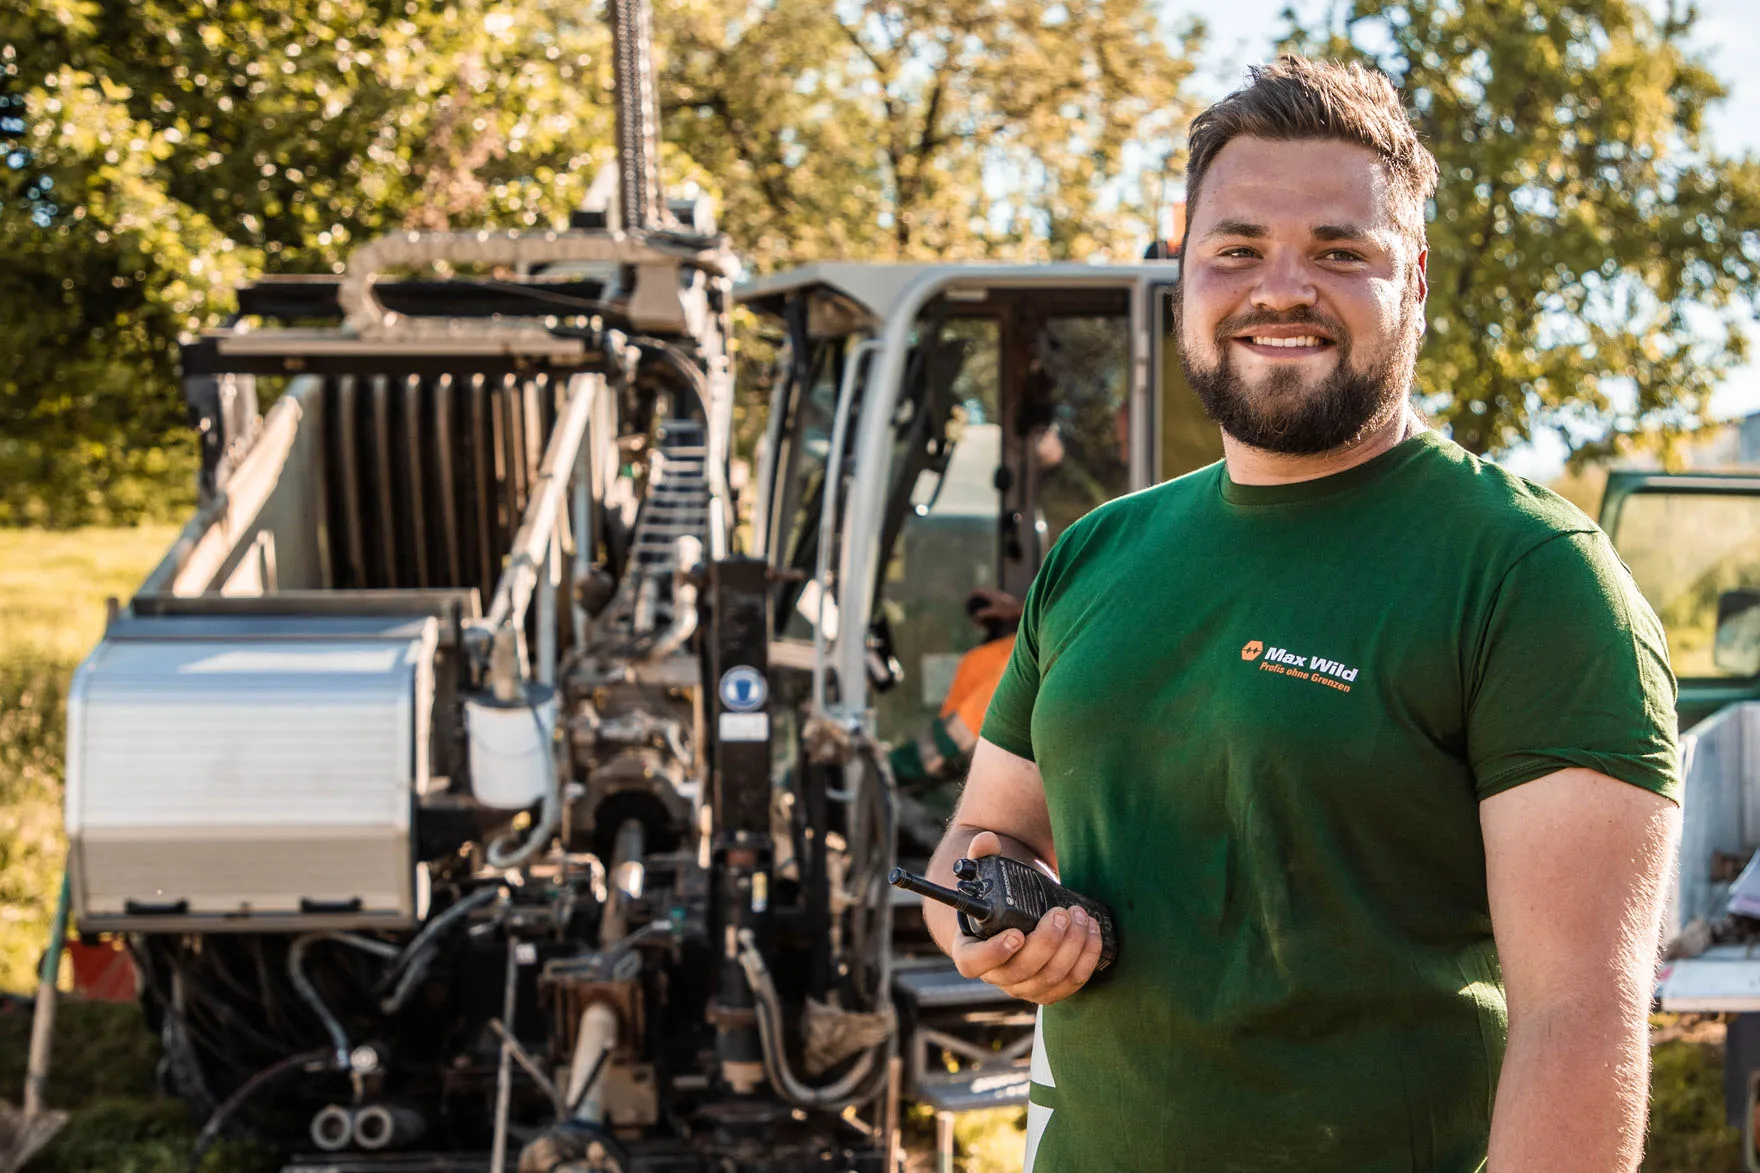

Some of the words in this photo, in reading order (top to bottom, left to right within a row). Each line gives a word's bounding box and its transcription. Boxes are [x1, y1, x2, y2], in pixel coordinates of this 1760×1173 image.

[1260, 661, 1285, 674] Profis
[1286, 668, 1309, 680] ohne
[1311, 673, 1351, 693] Grenzen
[1264, 647, 1307, 667] Max
[1309, 656, 1359, 682] Wild
